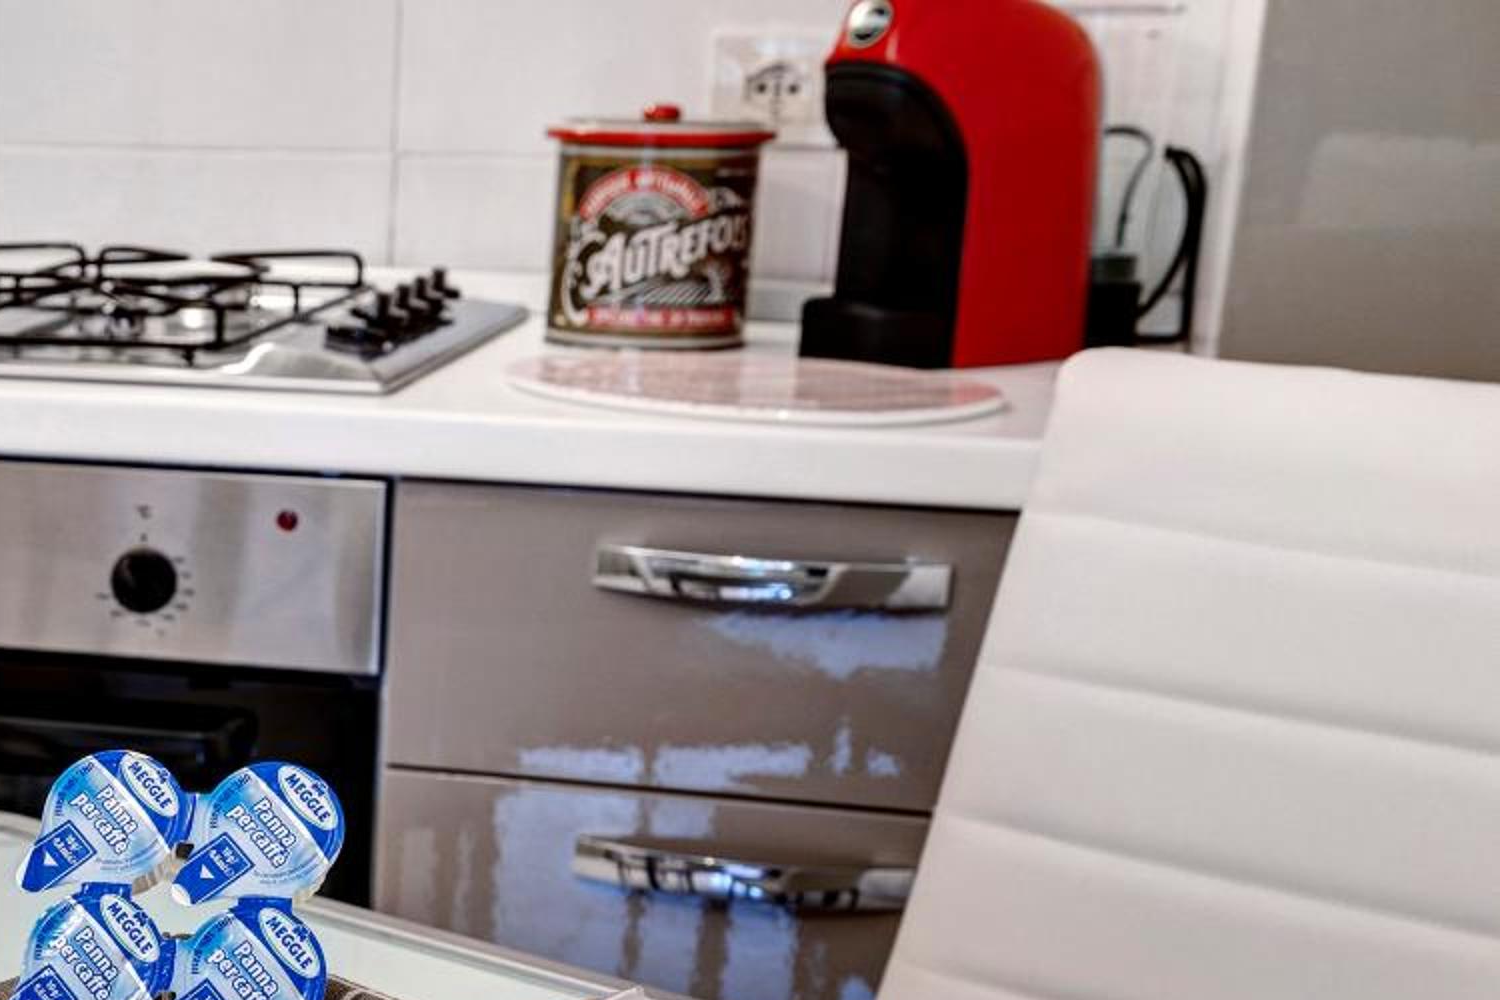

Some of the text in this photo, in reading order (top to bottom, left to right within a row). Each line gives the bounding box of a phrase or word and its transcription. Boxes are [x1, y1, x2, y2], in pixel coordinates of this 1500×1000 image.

[70, 793, 100, 825] per
[96, 784, 139, 834] Panna
[128, 761, 174, 810] MEGGLE
[284, 773, 332, 822] MEGGLE
[226, 805, 257, 838] per
[253, 797, 297, 850] Panna
[49, 936, 77, 963] per
[106, 901, 154, 955] MEGGLE
[265, 917, 314, 970] MEGGLE
[75, 926, 119, 981] Panna
[206, 949, 238, 979] per
[233, 940, 279, 998] Panna
